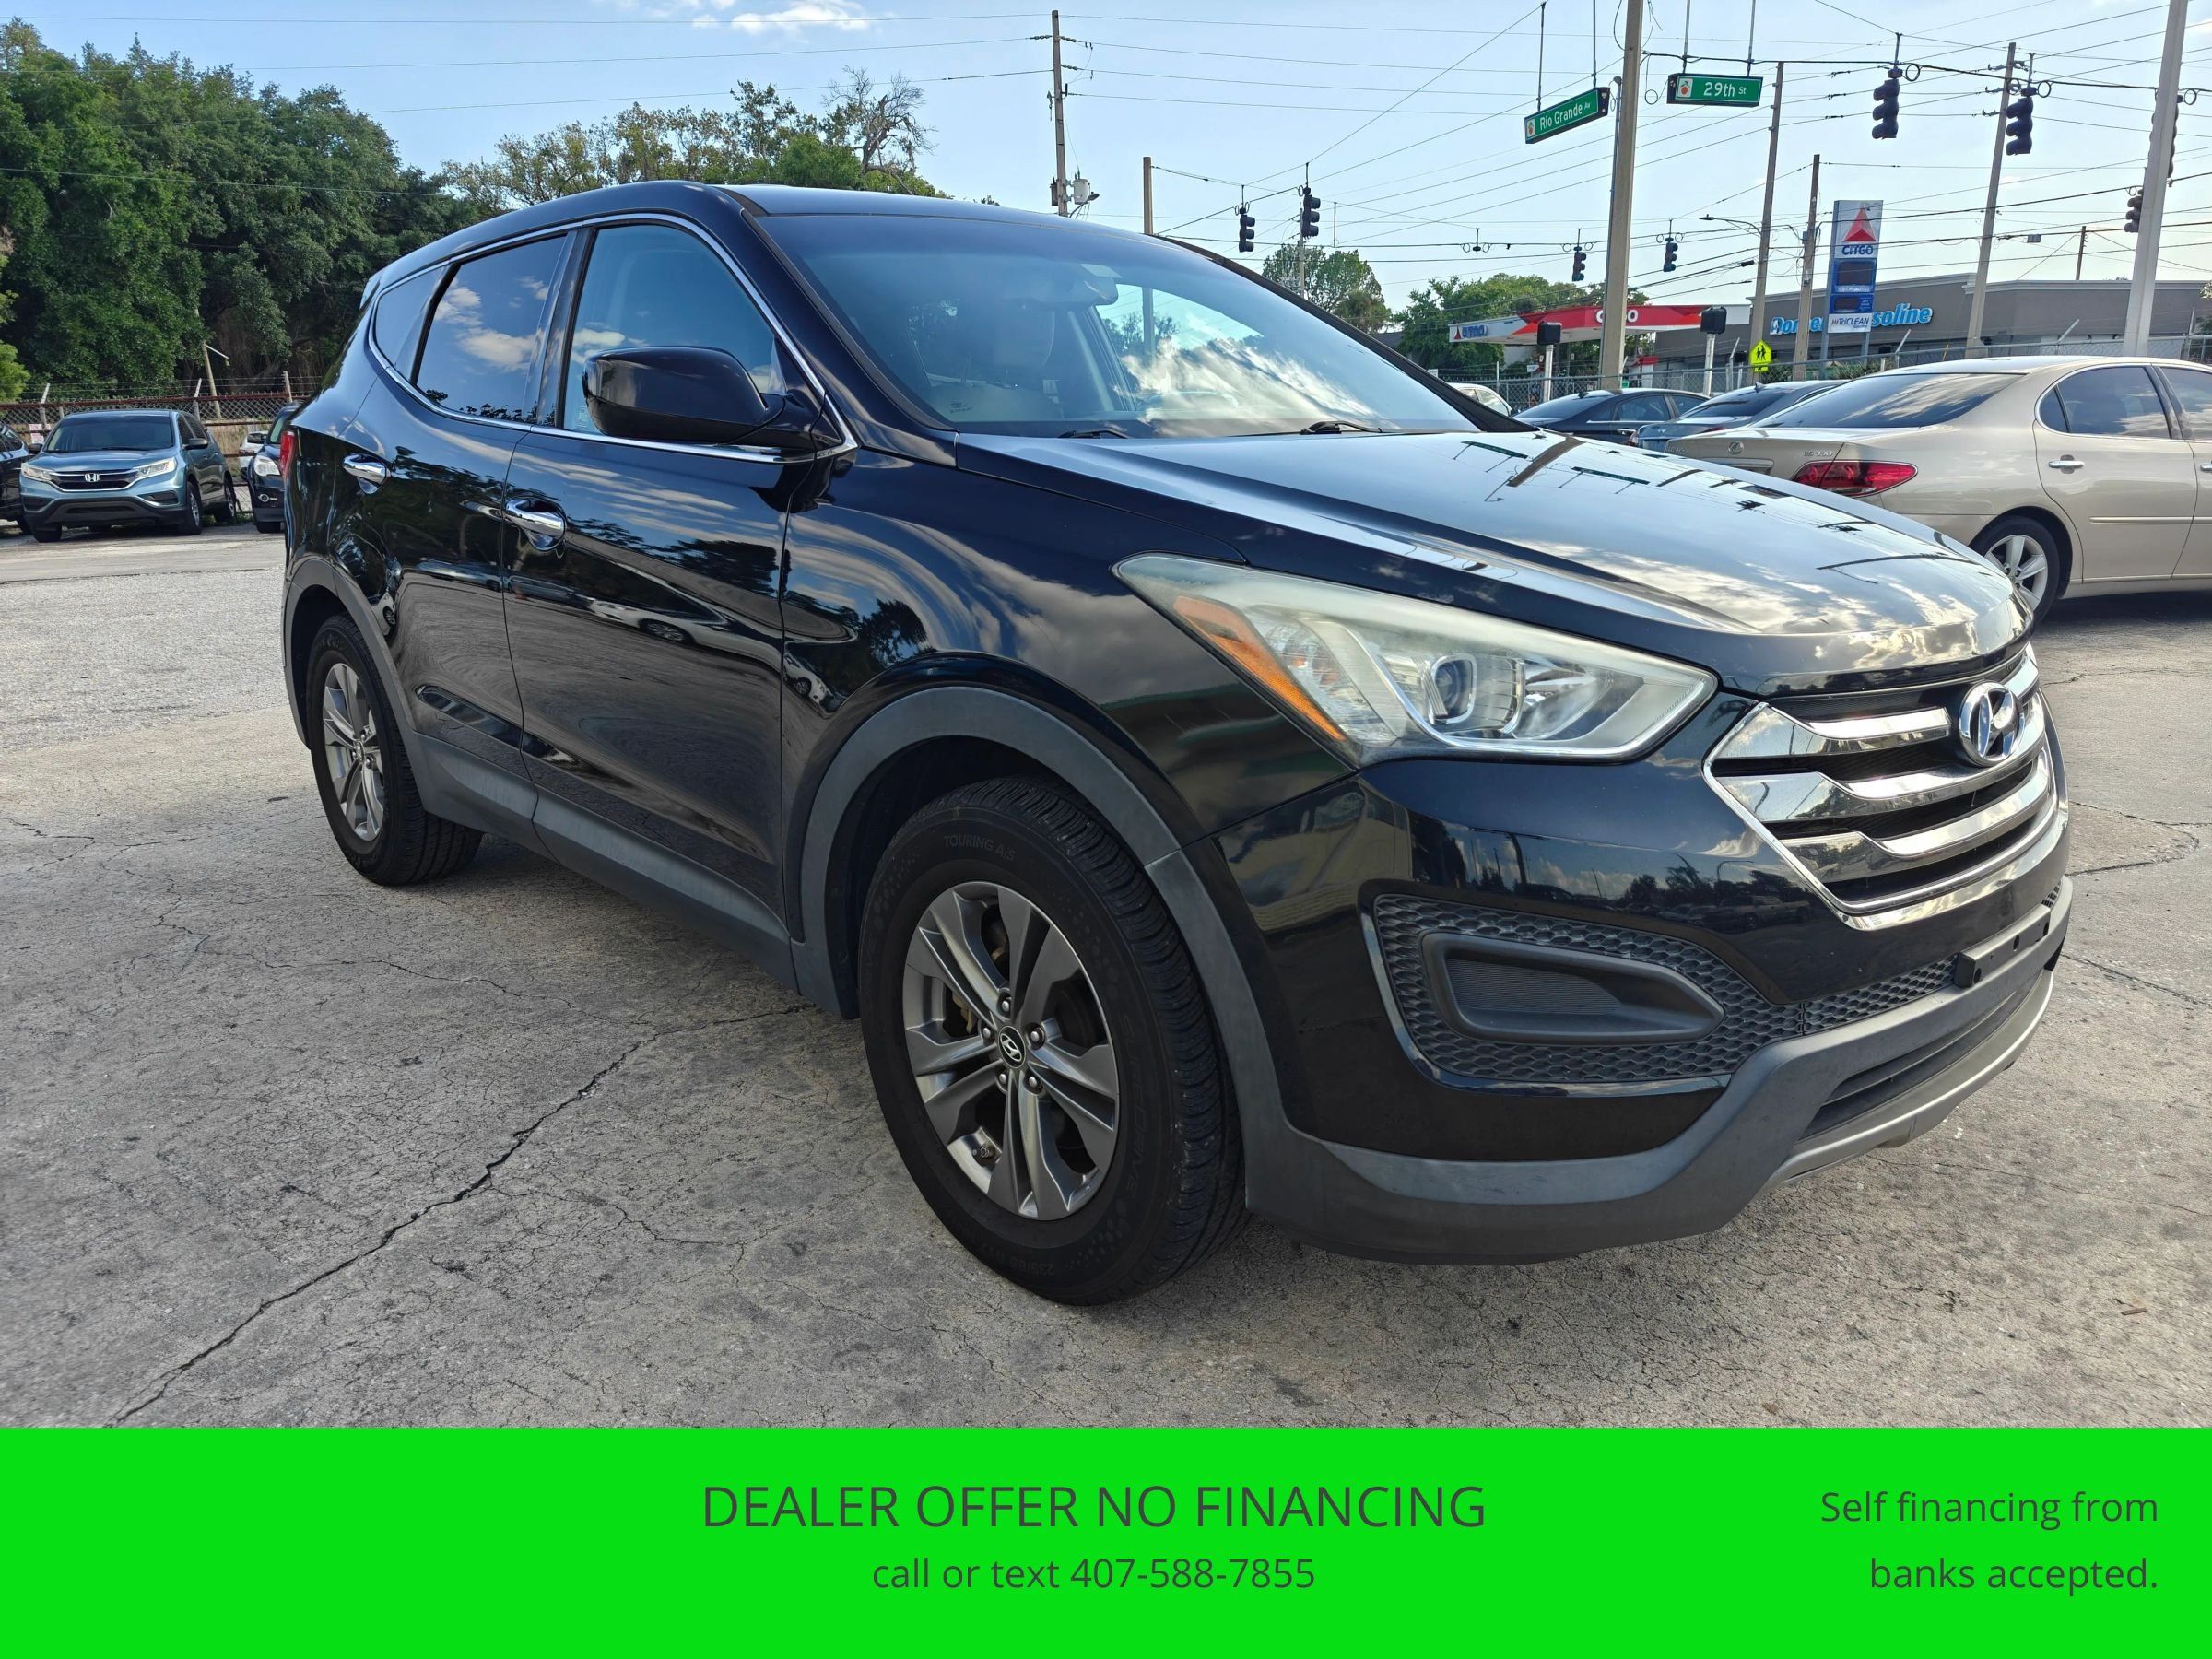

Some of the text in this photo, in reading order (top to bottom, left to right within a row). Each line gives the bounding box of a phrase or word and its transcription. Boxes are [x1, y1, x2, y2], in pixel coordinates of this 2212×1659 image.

[1703, 81, 1747, 97] 29th St
[1539, 115, 1552, 131] Rio
[1554, 103, 1583, 124] Grande
[1841, 244, 1874, 255] CITGO
[944, 833, 1017, 862] TOURING A/S
